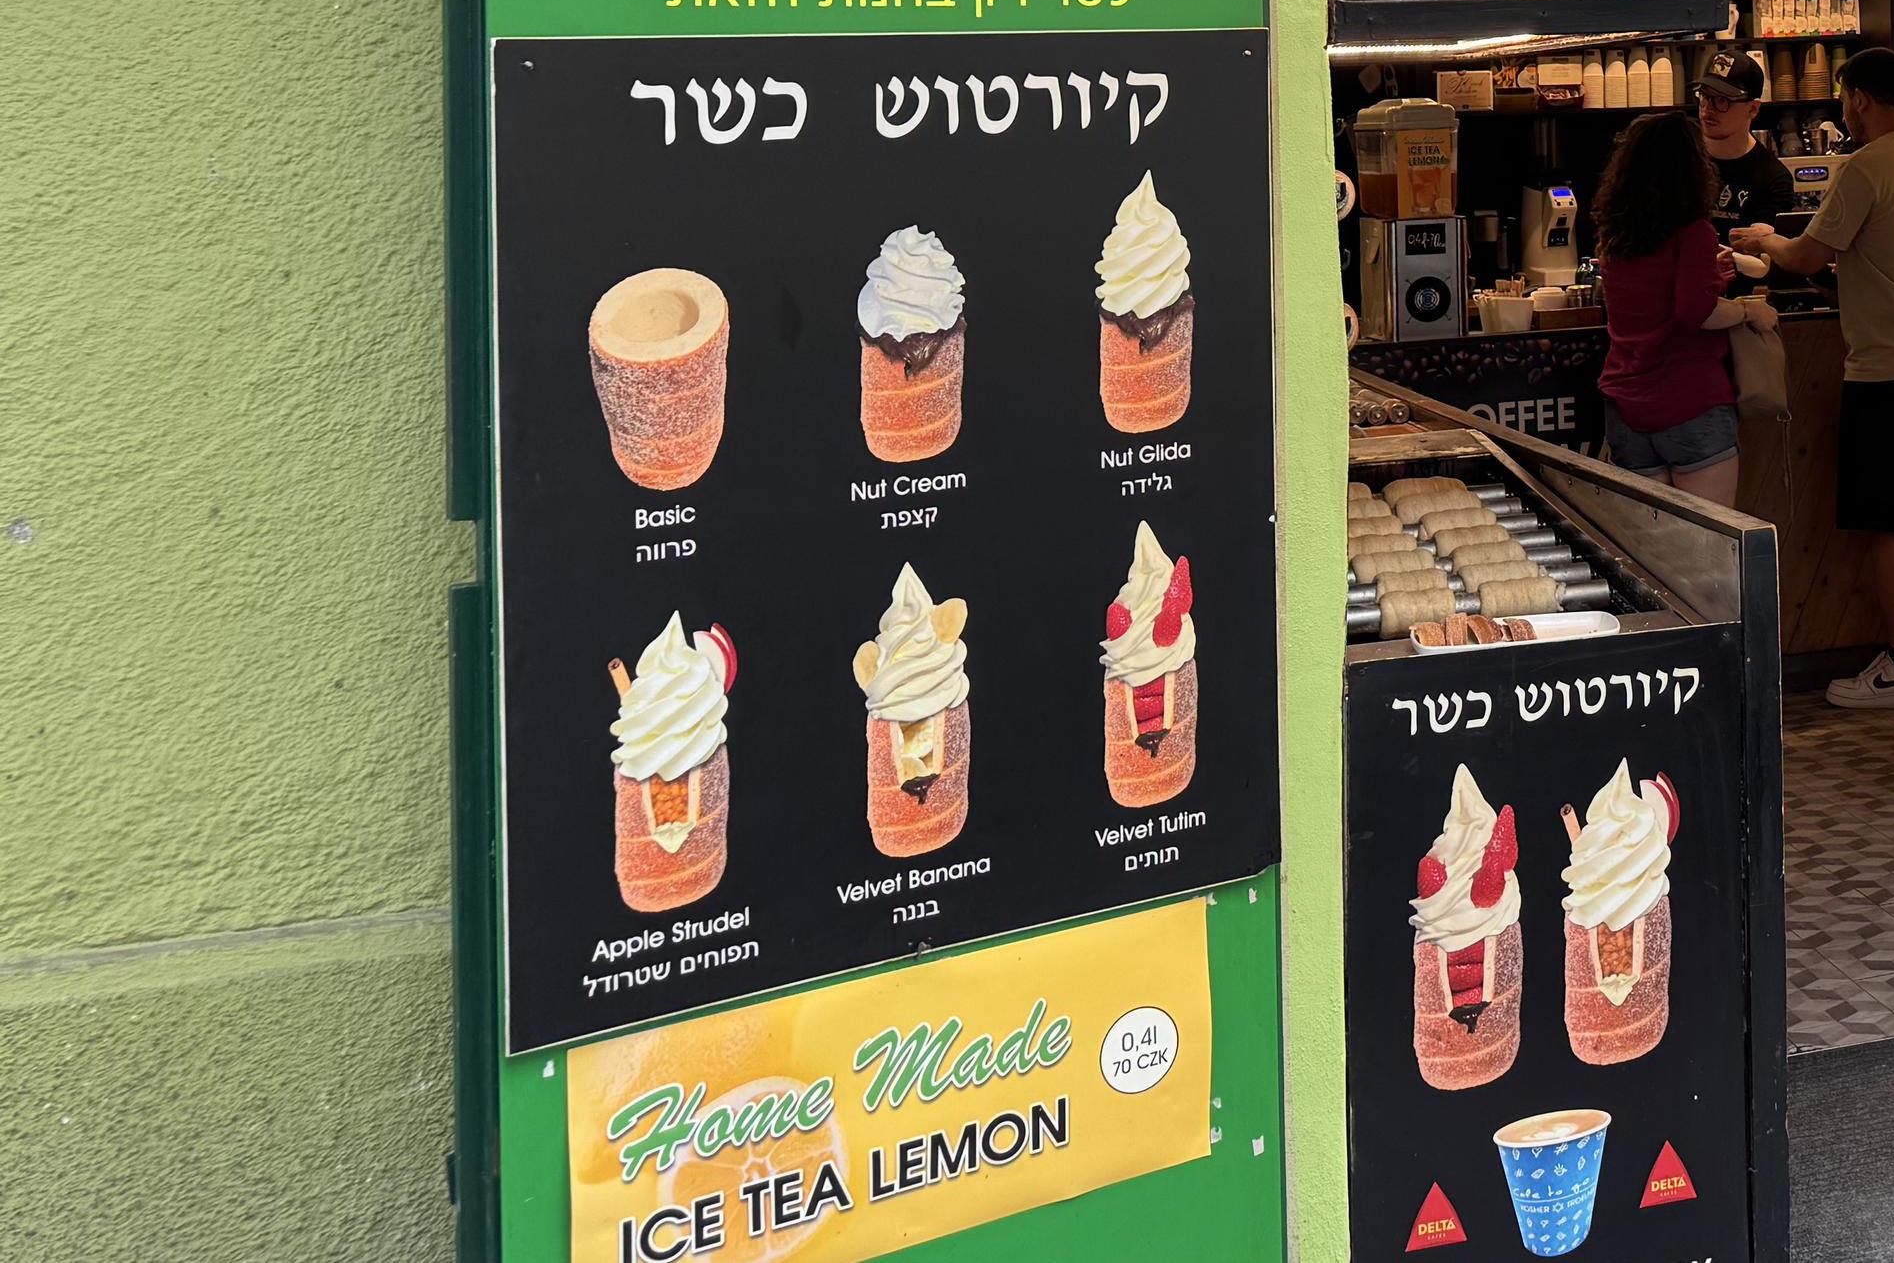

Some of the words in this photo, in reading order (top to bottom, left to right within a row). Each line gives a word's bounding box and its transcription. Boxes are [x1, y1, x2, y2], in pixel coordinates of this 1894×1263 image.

[631, 78, 808, 146] כשר
[875, 71, 1169, 146] קיורטוש
[1424, 145, 1440, 154] TEA
[1100, 445, 1135, 468] Nut
[1139, 441, 1191, 464] Glida
[849, 479, 887, 502] Nut
[893, 470, 967, 497] Cream
[1120, 474, 1173, 497] גלידה
[635, 504, 696, 529] Basic
[881, 506, 937, 531] קצפת
[635, 537, 697, 562] פרווה
[1515, 666, 1700, 723] קיורטוש
[1392, 690, 1494, 736] כשר
[1095, 819, 1154, 846] Velvet
[1159, 808, 1206, 840] Tutim
[1124, 844, 1179, 870] תותים
[838, 874, 902, 904] Velvet
[908, 857, 991, 891] Banana
[892, 899, 940, 924] בננה
[591, 927, 664, 966] Apple
[671, 907, 750, 943] Strudel
[680, 939, 760, 974] תפוחים
[583, 960, 672, 999] שטרודל
[1112, 1058, 1139, 1077] 70
[1142, 1051, 1169, 1072] CZK
[607, 1074, 836, 1182] Home
[853, 998, 1072, 1112] Made
[618, 1197, 725, 1263] ICE
[743, 1166, 853, 1238] TEA
[869, 1096, 1069, 1198] LEMON
[1651, 1176, 1686, 1192] DELTA
[1418, 1218, 1455, 1235] DELTA
